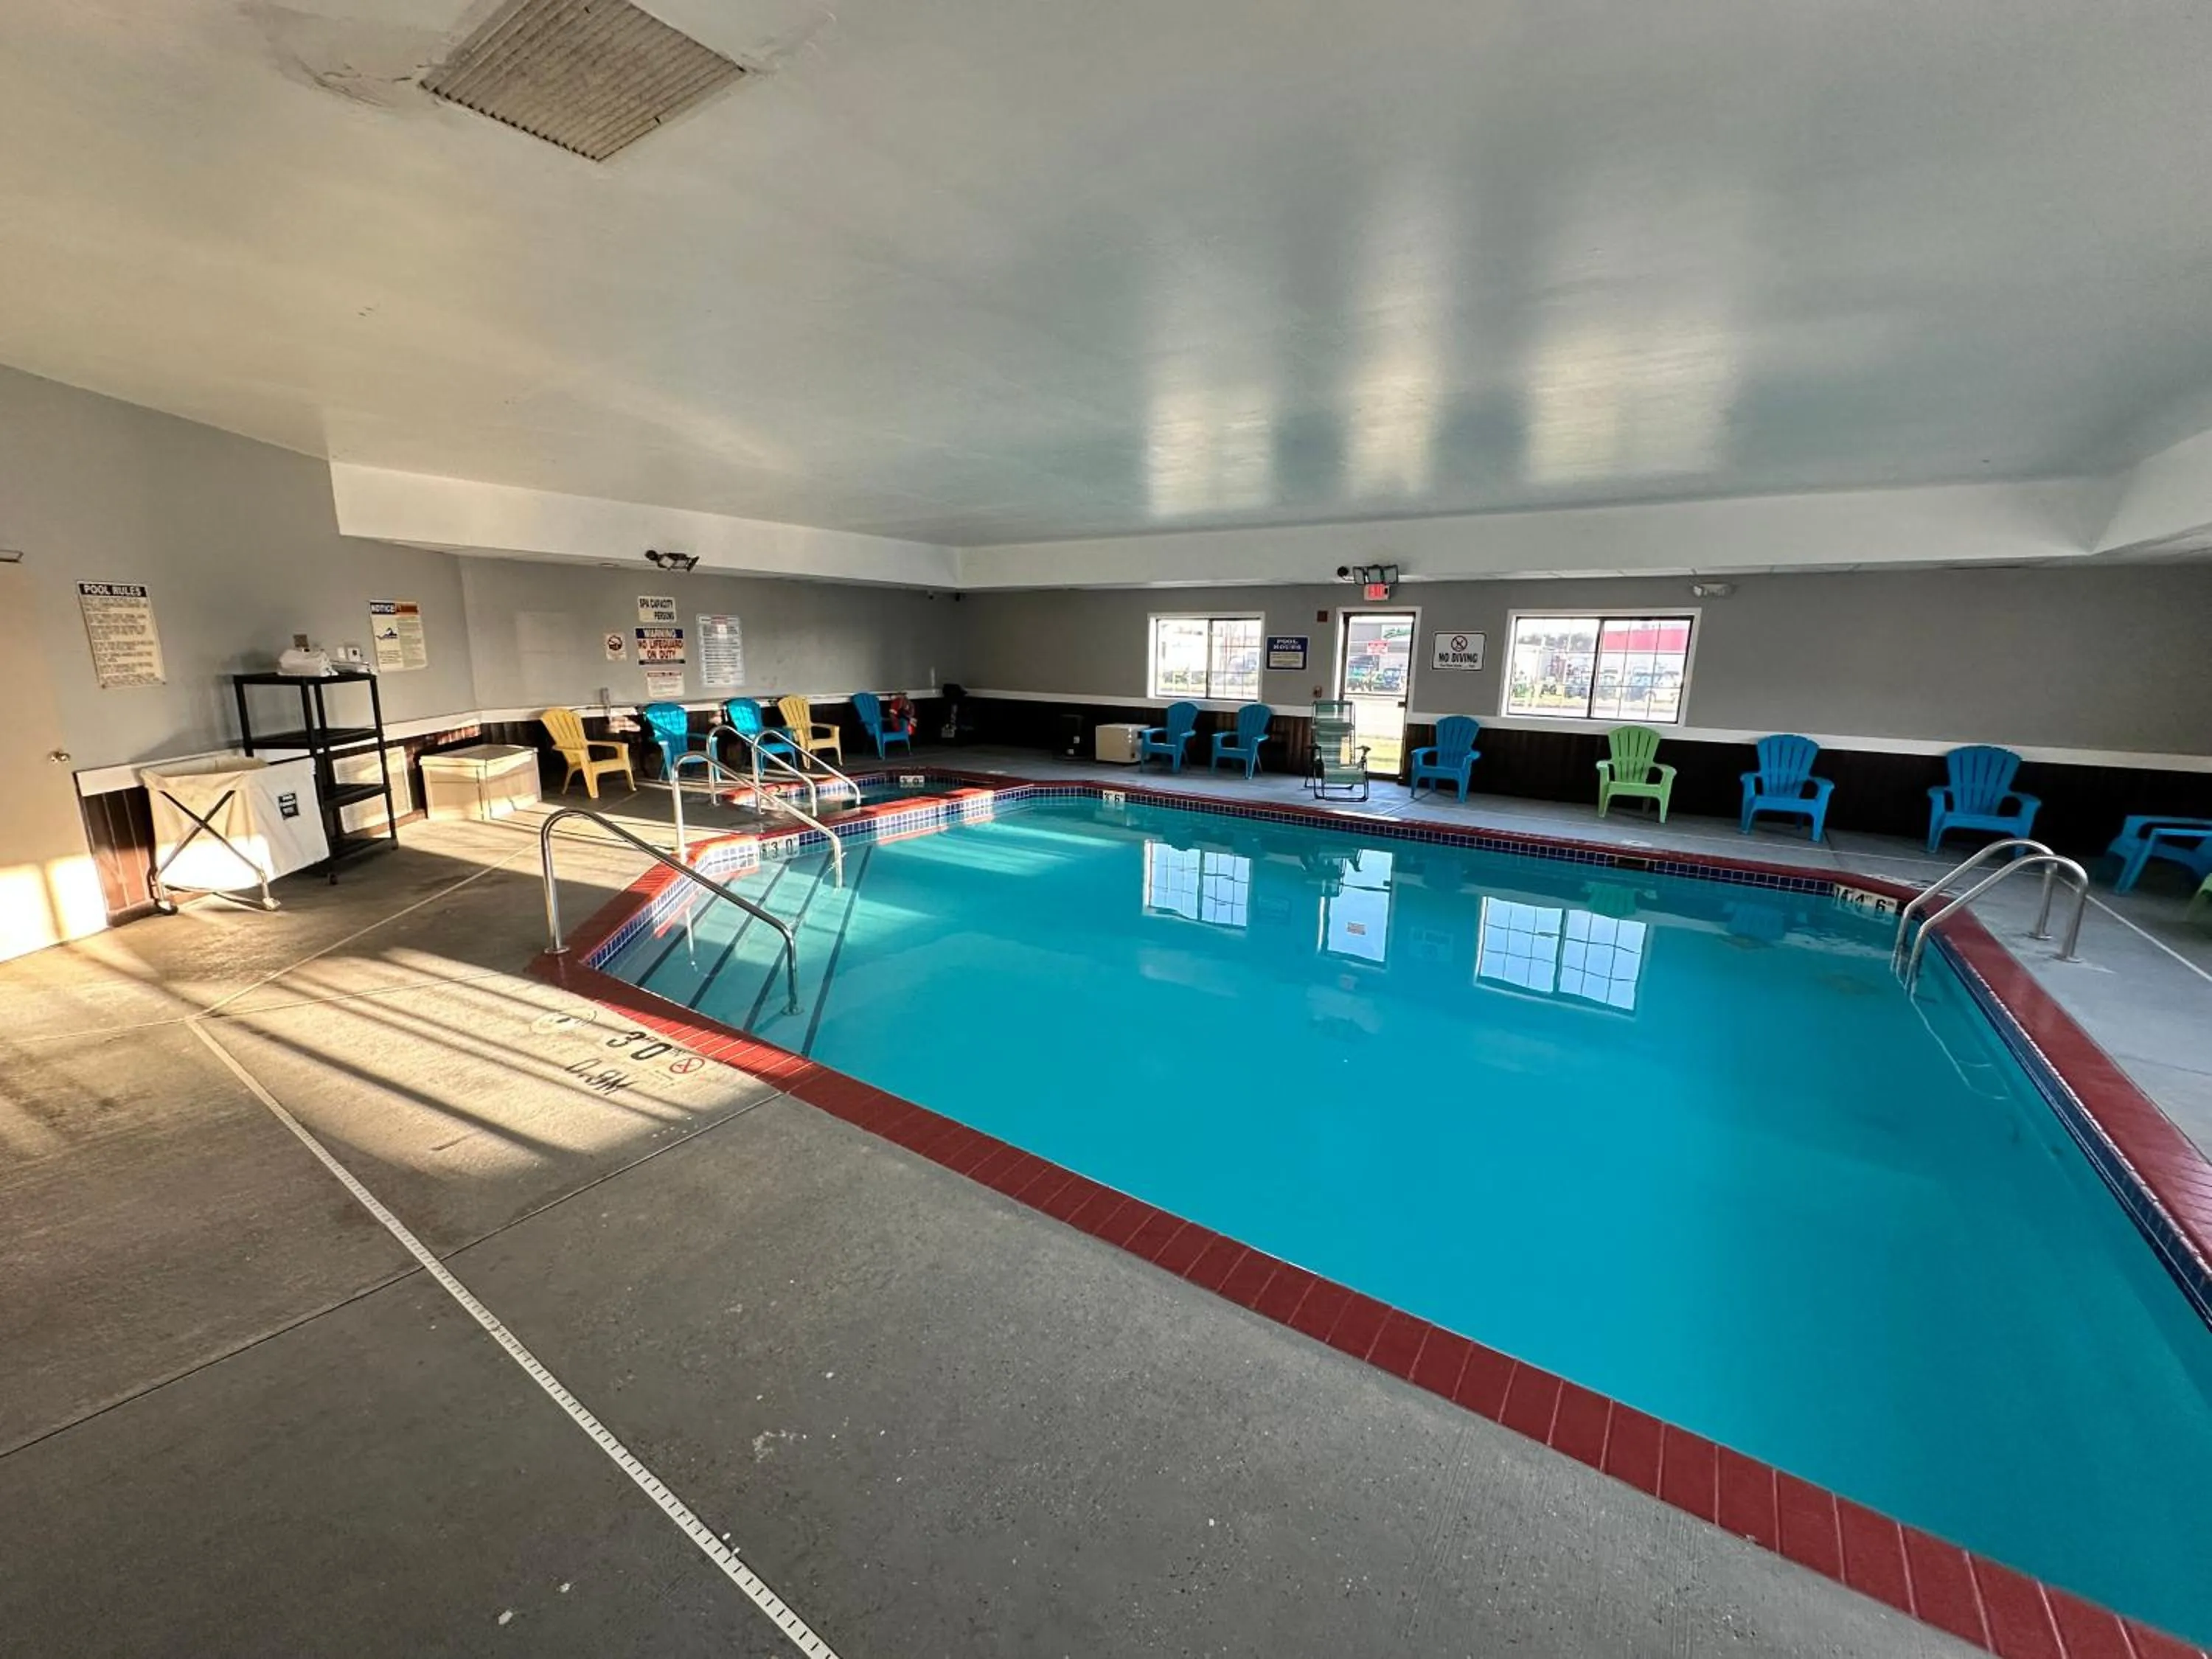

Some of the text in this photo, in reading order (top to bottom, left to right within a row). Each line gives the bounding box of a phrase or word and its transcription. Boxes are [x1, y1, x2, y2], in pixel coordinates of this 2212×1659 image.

[83, 585, 141, 596] POOL RULES
[371, 604, 395, 613] NOTICE
[650, 599, 673, 609] CAPACITY
[654, 611, 675, 620] PERSONS
[637, 639, 683, 650] NO LIFEGUARD
[647, 650, 676, 659] ON DUTY
[1439, 653, 1478, 663] NO DIVING
